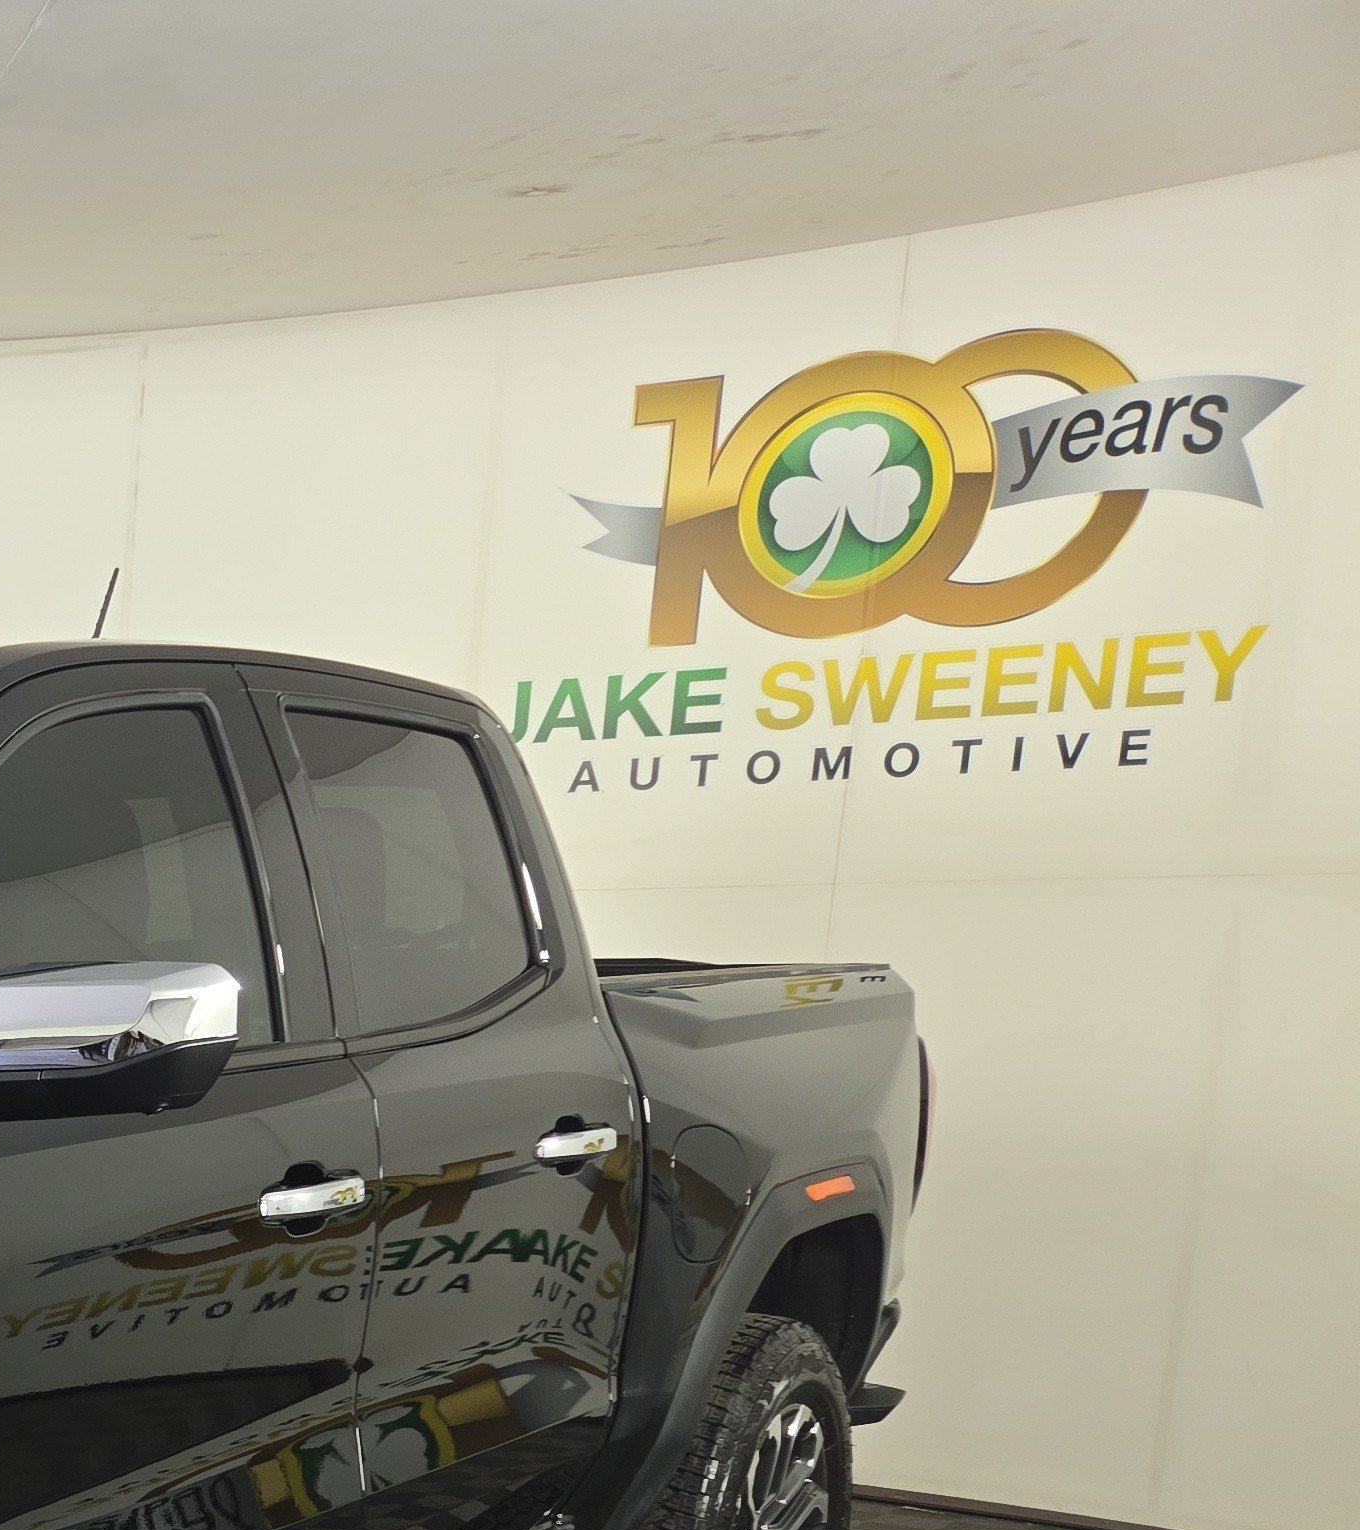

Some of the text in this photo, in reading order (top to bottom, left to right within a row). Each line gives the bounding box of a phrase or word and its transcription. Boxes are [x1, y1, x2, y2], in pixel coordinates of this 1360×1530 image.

[633, 328, 1230, 647] 100 years
[507, 623, 1269, 746] JAKE SWEENEY
[568, 729, 1153, 795] AUTOMOTIVE
